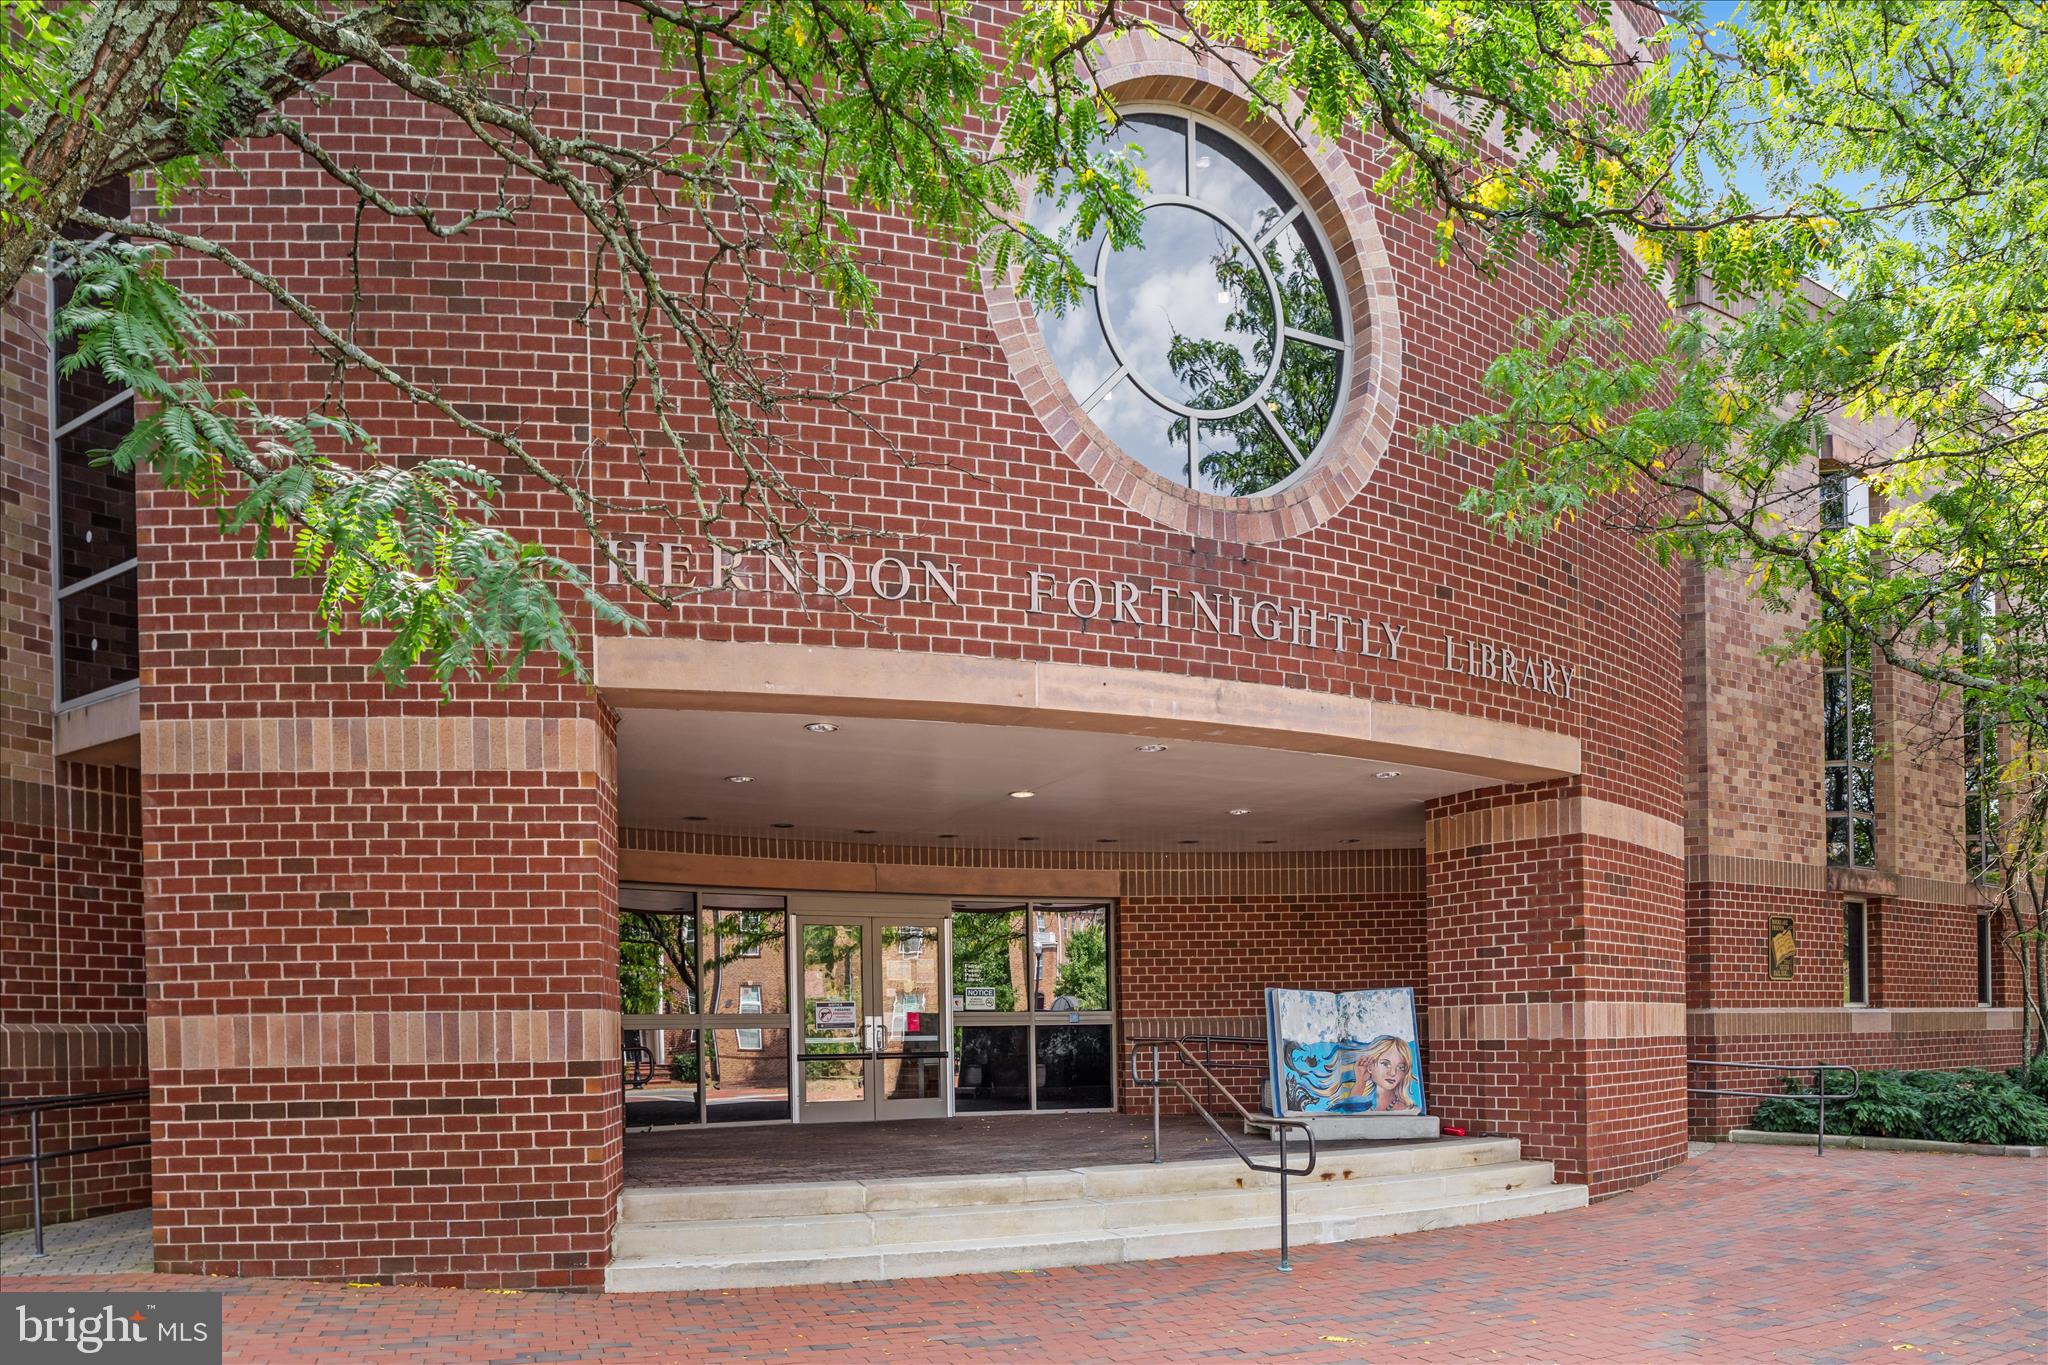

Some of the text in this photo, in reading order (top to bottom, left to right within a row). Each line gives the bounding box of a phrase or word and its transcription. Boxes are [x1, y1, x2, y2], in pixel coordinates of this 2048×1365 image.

[605, 540, 1576, 700] HERNDON FORTNIGHTLY LIBRARY
